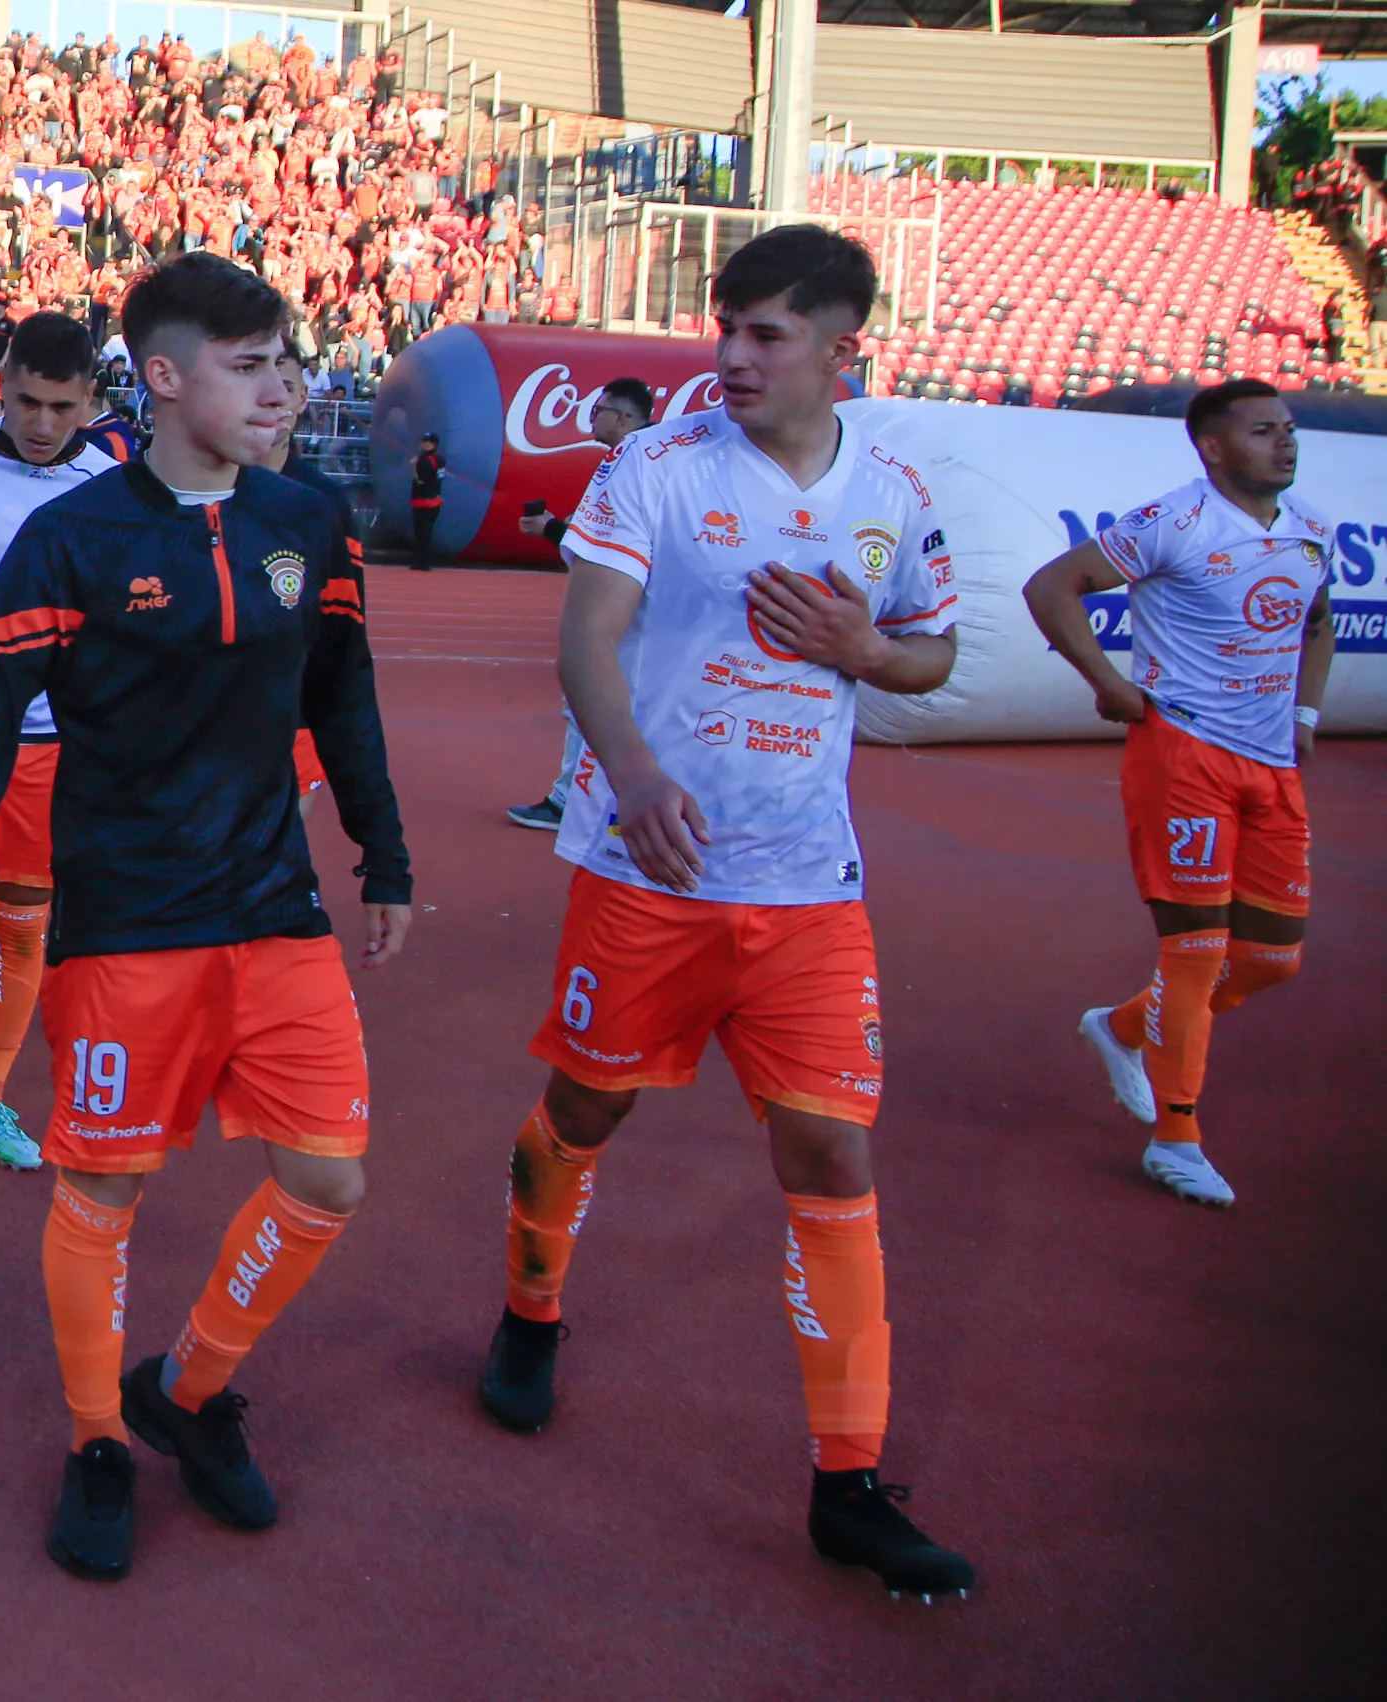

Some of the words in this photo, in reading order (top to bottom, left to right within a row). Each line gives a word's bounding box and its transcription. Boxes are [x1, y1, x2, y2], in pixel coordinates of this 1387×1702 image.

[1263, 50, 1306, 70] A10
[778, 526, 828, 543] CODELCO
[720, 653, 750, 669] Filial
[751, 661, 766, 672] de
[745, 736, 813, 758] RENTAL
[1167, 817, 1218, 867] 27
[562, 965, 598, 1032] 6
[72, 1036, 129, 1116] 19
[227, 1215, 283, 1309] BALAP
